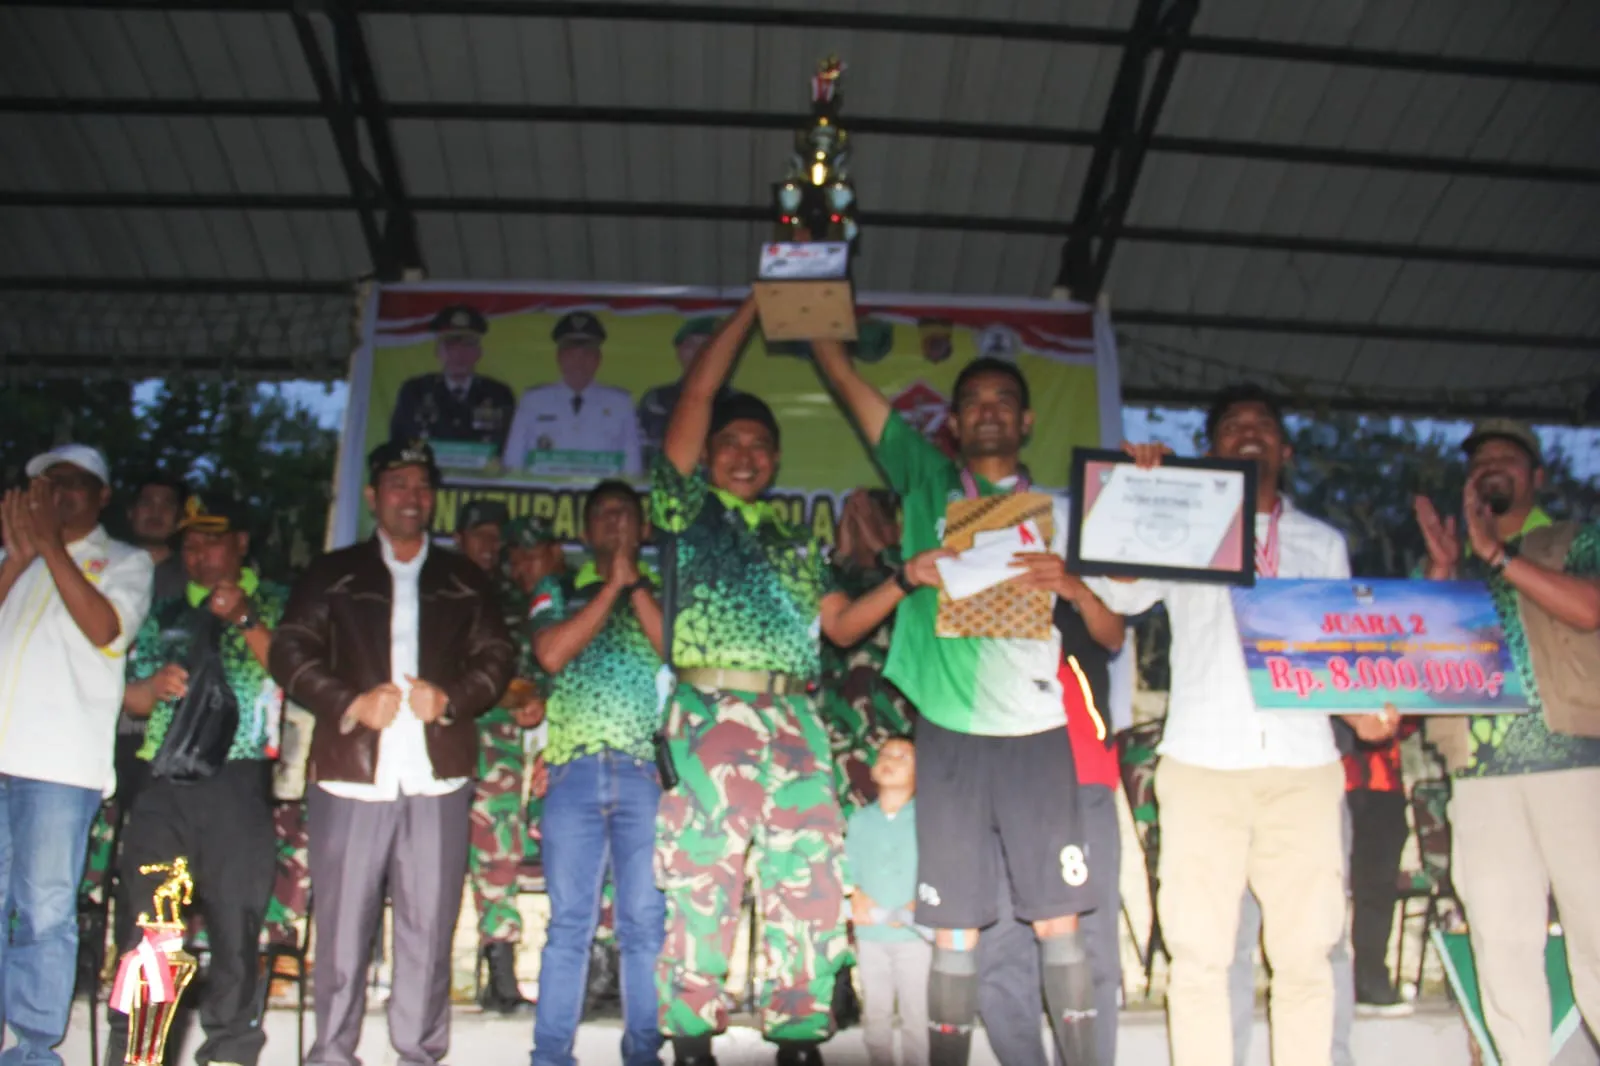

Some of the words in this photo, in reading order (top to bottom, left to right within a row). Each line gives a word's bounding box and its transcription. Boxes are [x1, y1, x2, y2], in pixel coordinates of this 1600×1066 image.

[1321, 611, 1403, 636] JUARA
[1408, 613, 1428, 635] 2
[1266, 656, 1325, 698] Rp.
[1060, 844, 1088, 886] 8
